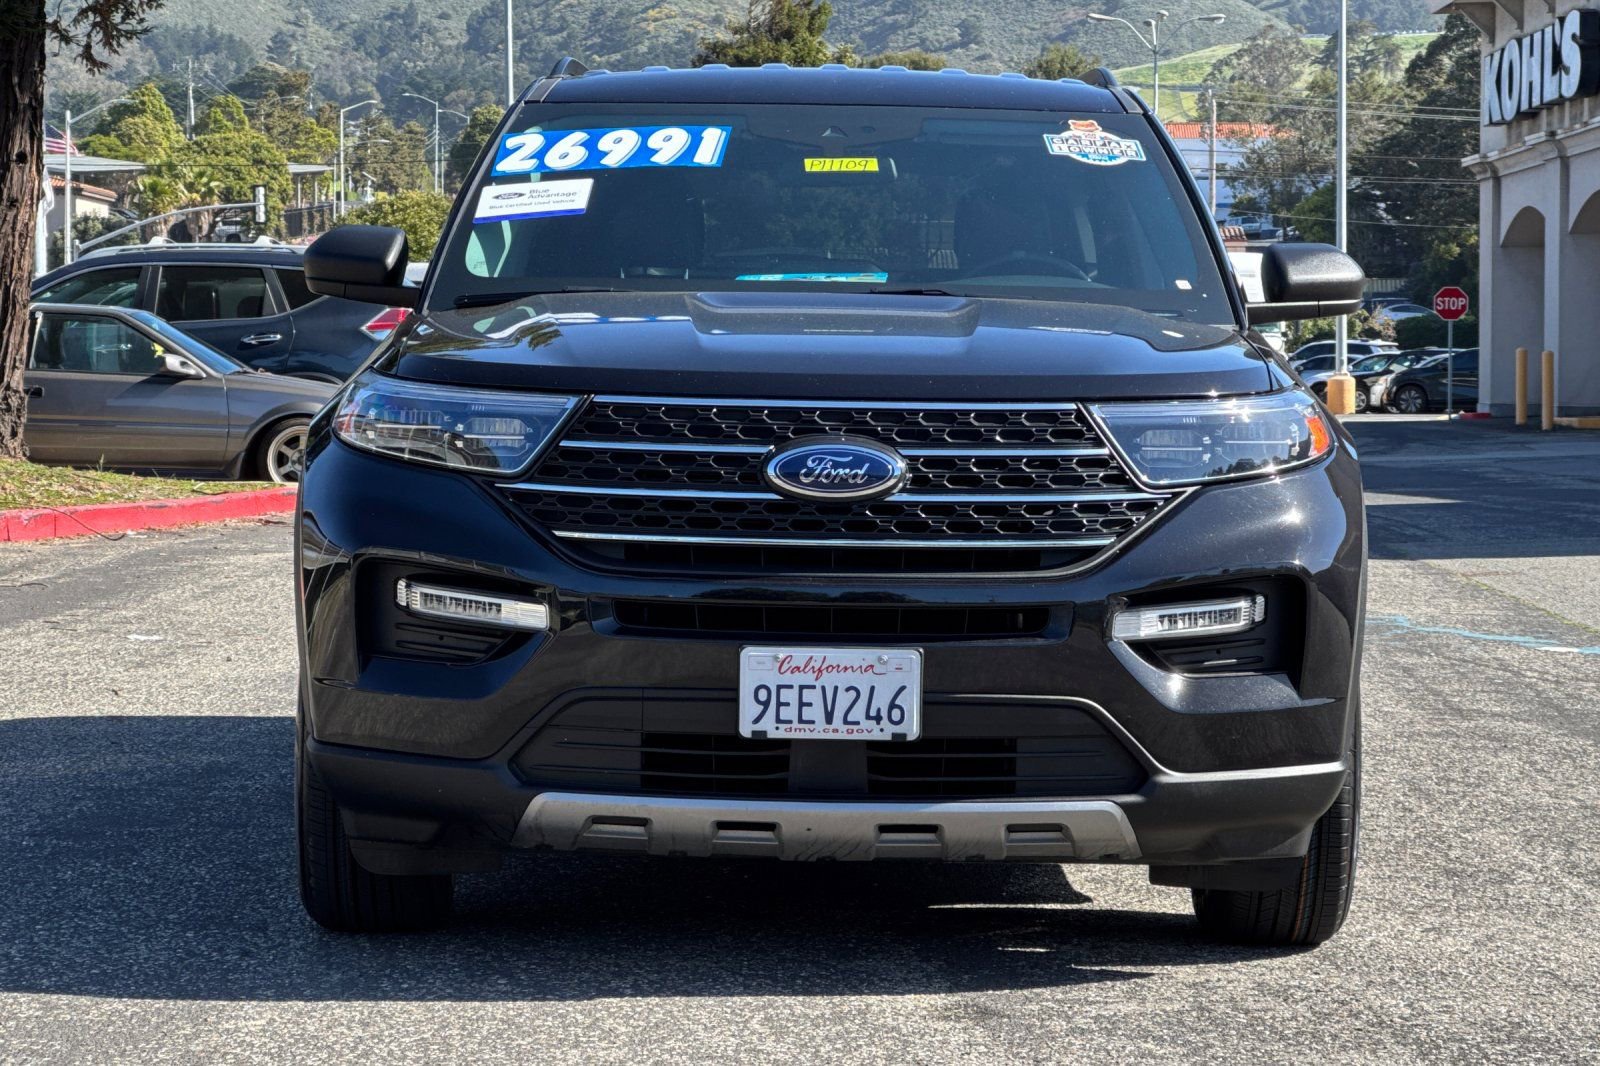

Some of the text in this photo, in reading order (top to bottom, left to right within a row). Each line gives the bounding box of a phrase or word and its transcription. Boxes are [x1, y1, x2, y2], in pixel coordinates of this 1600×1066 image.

[1483, 9, 1581, 127] KOHL'S
[495, 127, 727, 173] 26991
[528, 191, 578, 199] Advantage
[1436, 297, 1466, 310] STOP
[799, 455, 870, 484] Ford
[778, 655, 887, 681] California
[752, 684, 907, 726] 9EEV246
[784, 726, 874, 735] dmv.ca.gov
